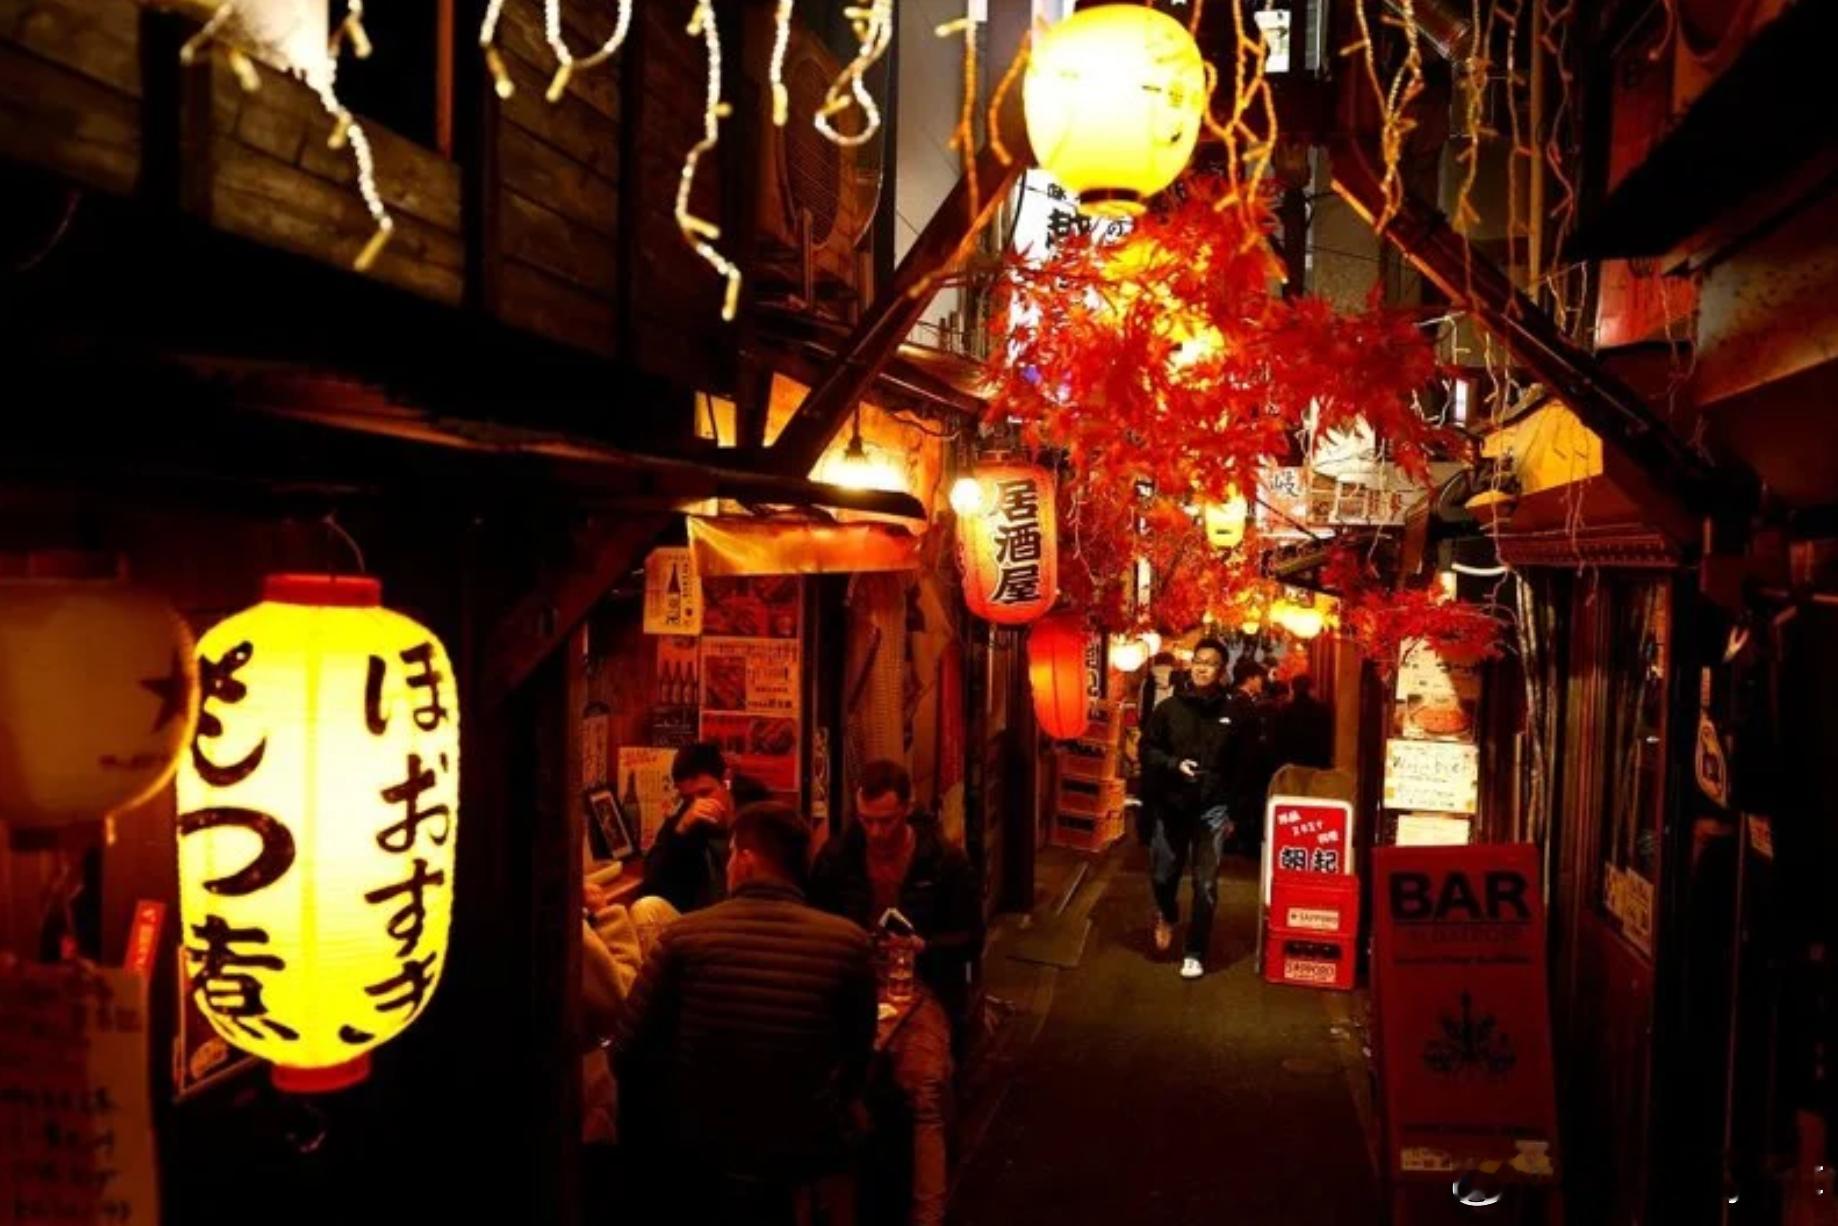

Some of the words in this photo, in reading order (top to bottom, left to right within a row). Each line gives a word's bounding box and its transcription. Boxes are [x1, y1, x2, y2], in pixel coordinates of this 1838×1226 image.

[991, 480, 1041, 604] 居酒屋
[1389, 871, 1532, 920] BAR
